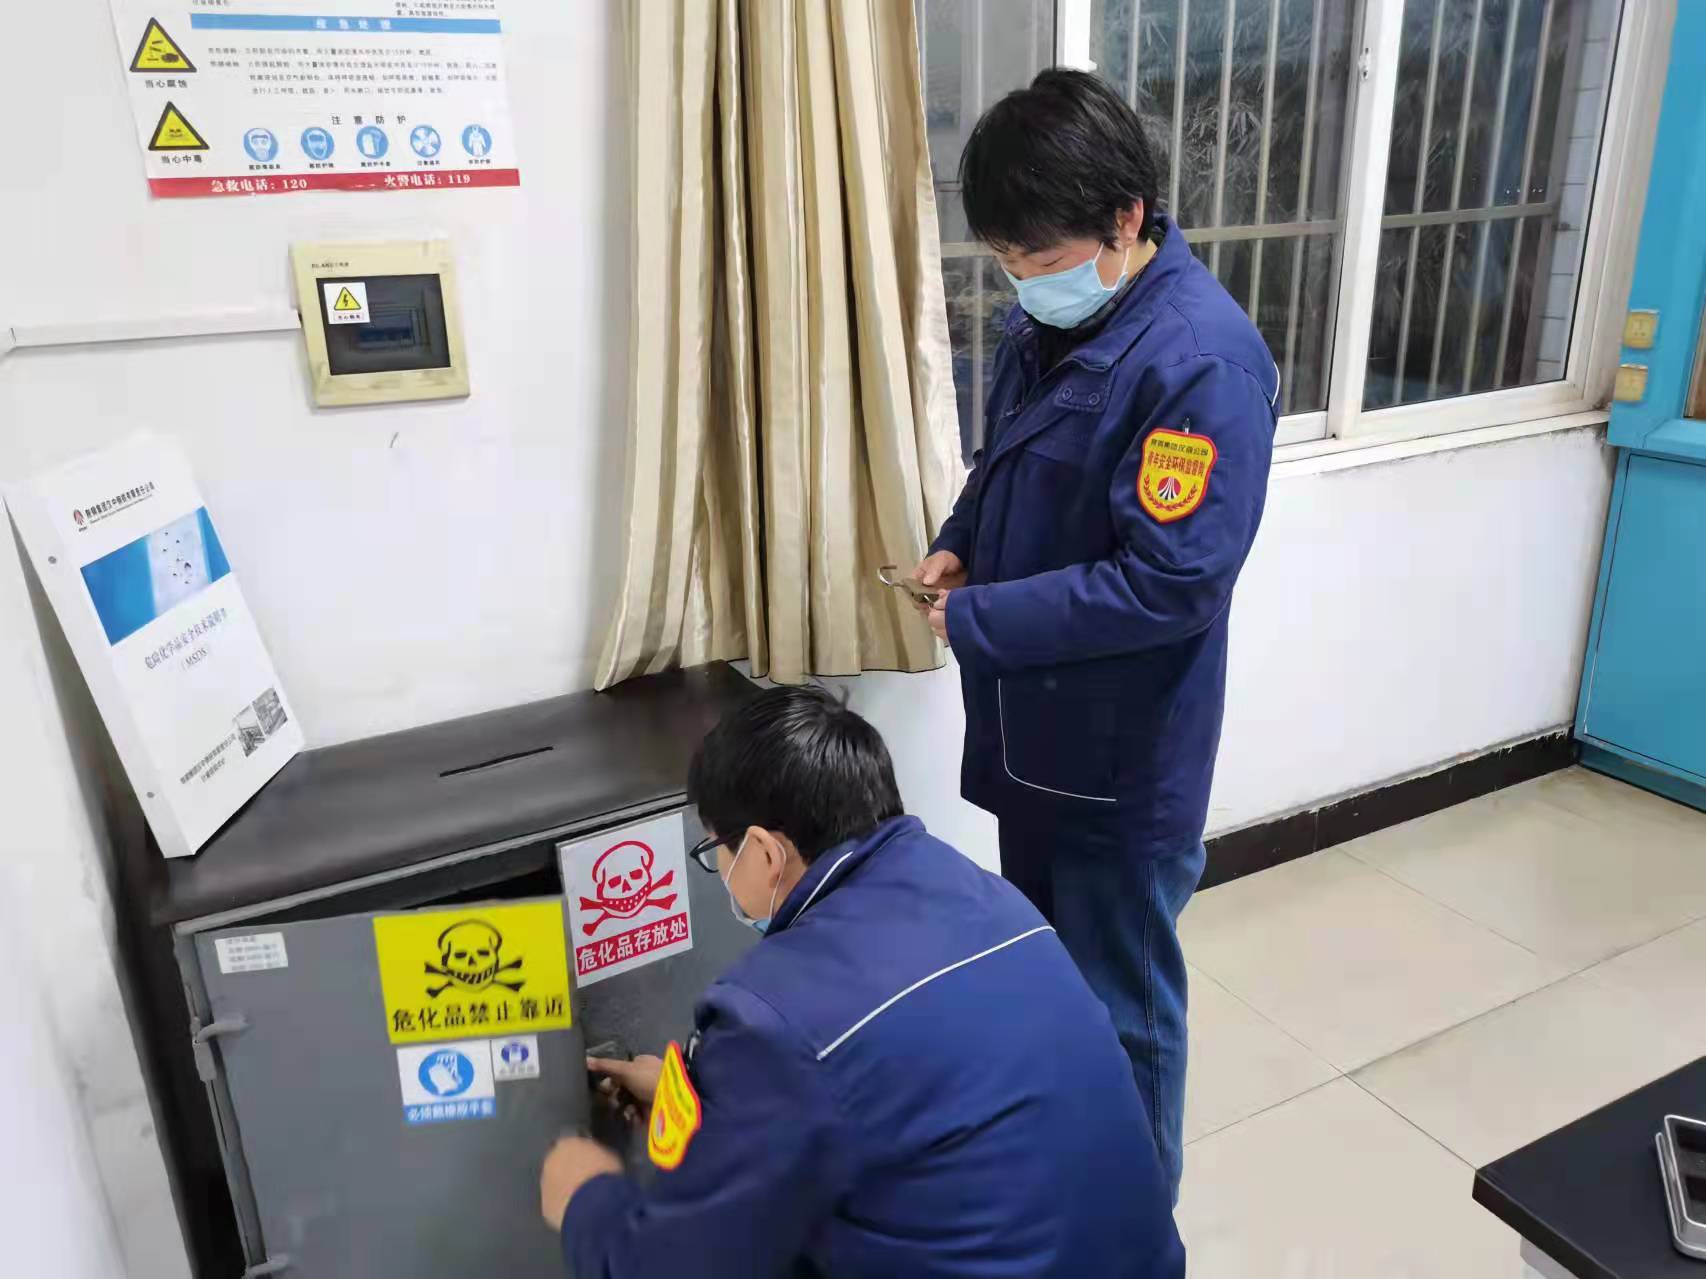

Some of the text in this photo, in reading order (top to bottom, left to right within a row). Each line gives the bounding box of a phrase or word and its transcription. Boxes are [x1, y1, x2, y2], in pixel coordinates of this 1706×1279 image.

[145, 79, 188, 89] 当心腐蚀
[331, 115, 406, 125] 注意防护
[161, 154, 203, 164] 当心中毒
[579, 917, 686, 972] 危化品存放处
[393, 996, 564, 1032] 危化品禁止靠近
